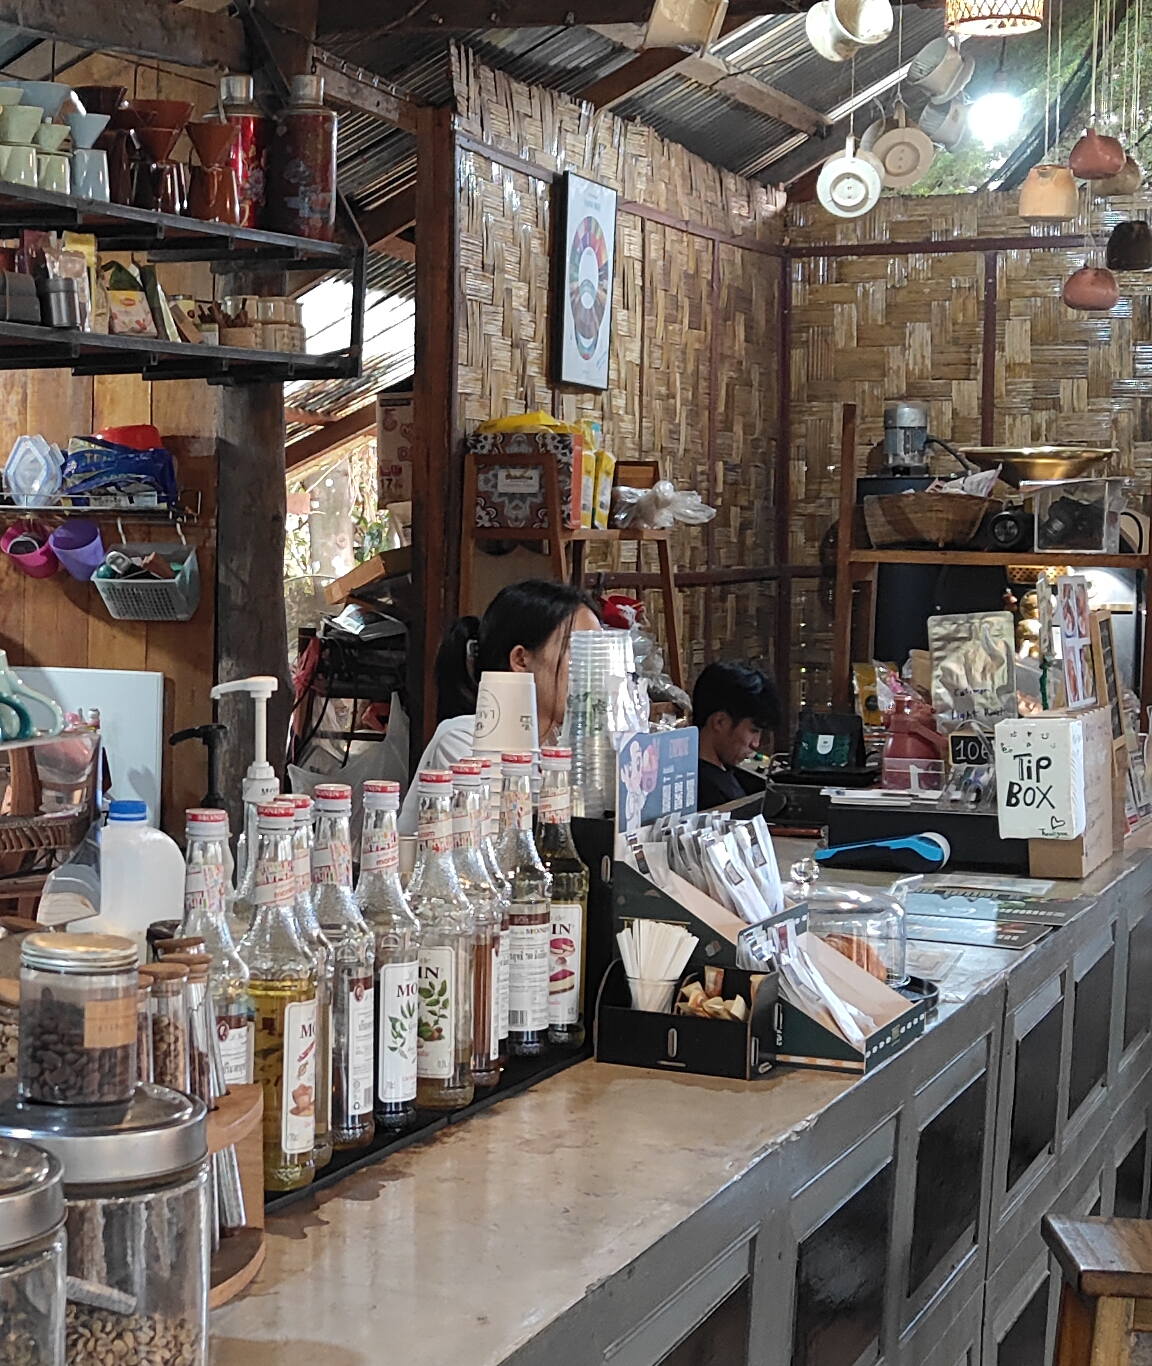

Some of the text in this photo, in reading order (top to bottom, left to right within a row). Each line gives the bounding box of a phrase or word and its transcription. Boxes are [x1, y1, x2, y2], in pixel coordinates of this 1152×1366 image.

[1005, 781, 1056, 810] BOX
[551, 922, 571, 935] IN
[418, 966, 440, 979] IN
[396, 981, 418, 998] MO
